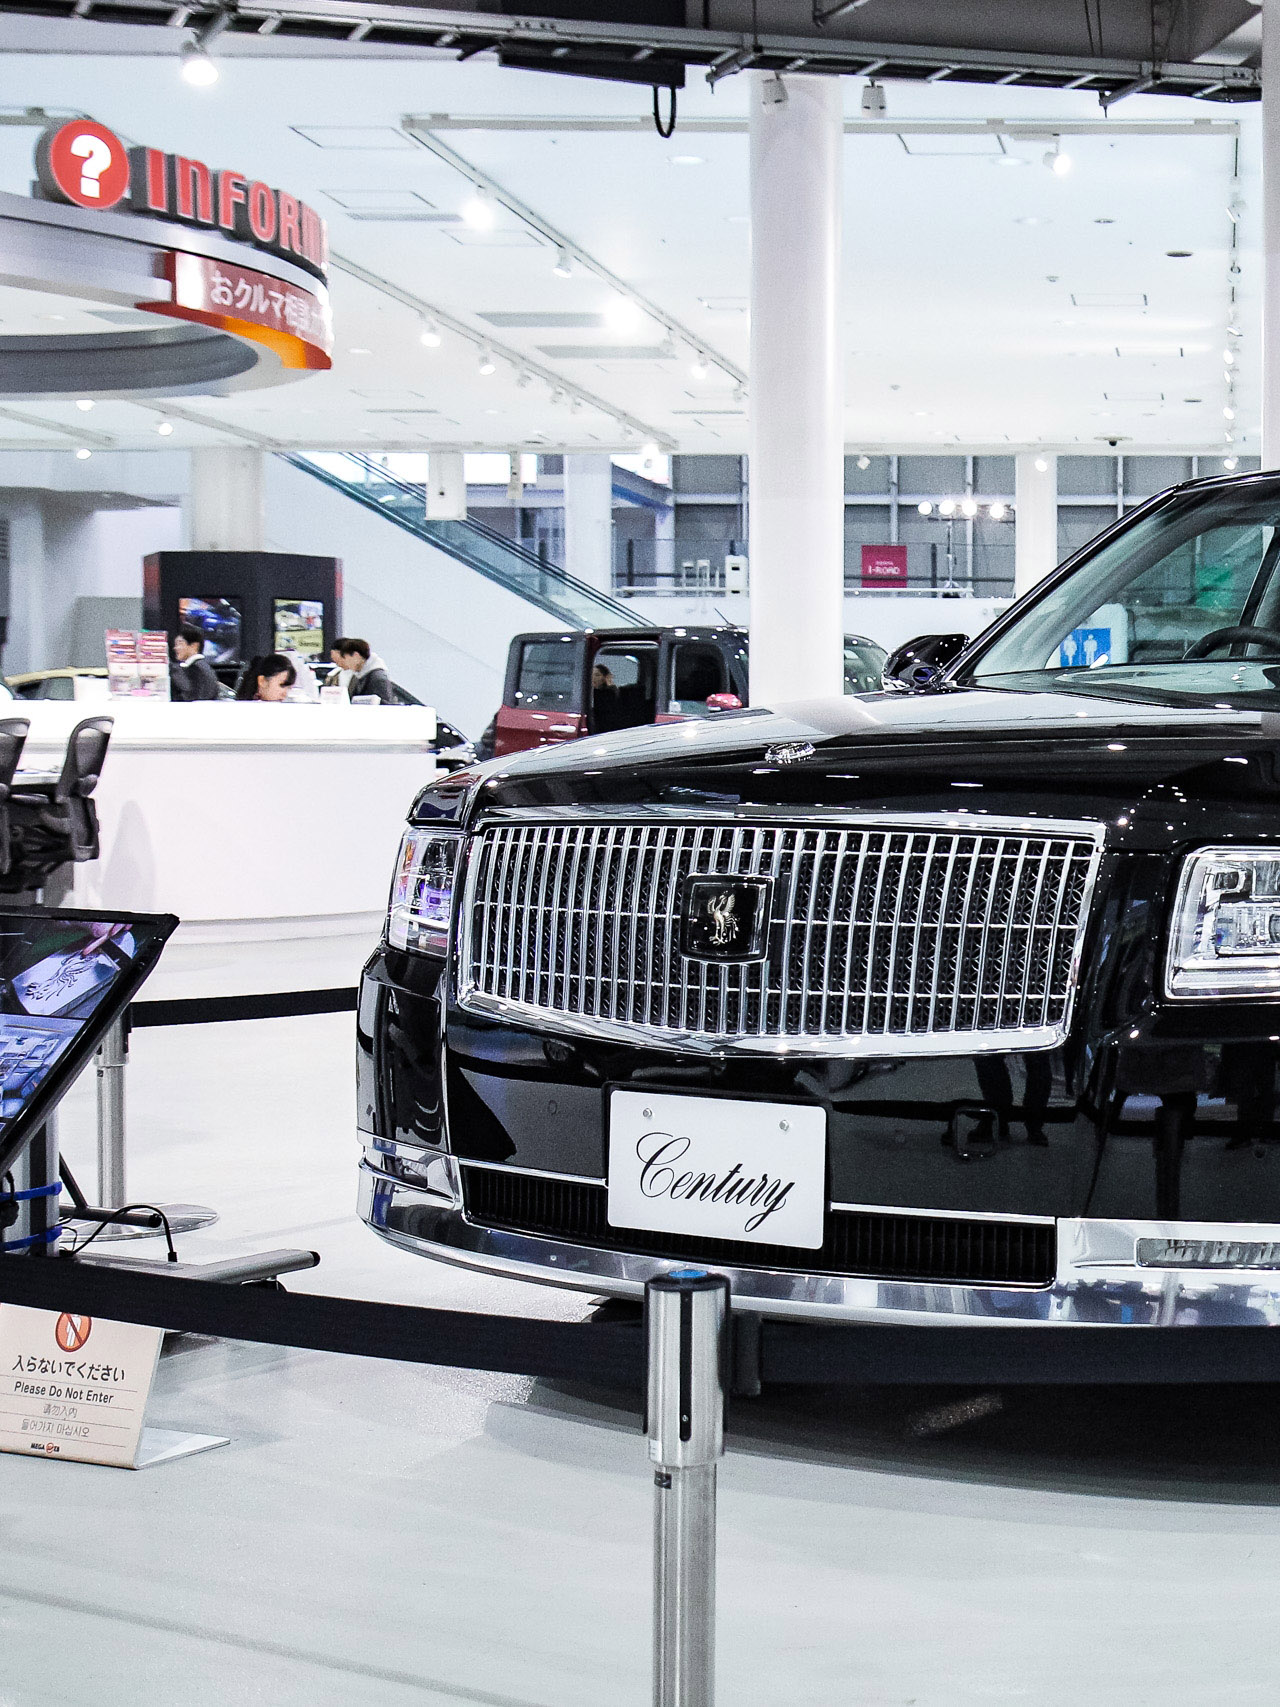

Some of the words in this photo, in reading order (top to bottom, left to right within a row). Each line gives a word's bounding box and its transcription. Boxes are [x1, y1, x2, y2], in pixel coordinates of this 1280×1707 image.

[636, 1131, 796, 1233] Century
[12, 1355, 125, 1381] 入らないでください
[14, 1381, 46, 1395] Please
[49, 1385, 62, 1397] Do
[65, 1387, 83, 1400] Not
[86, 1390, 114, 1404] Enter
